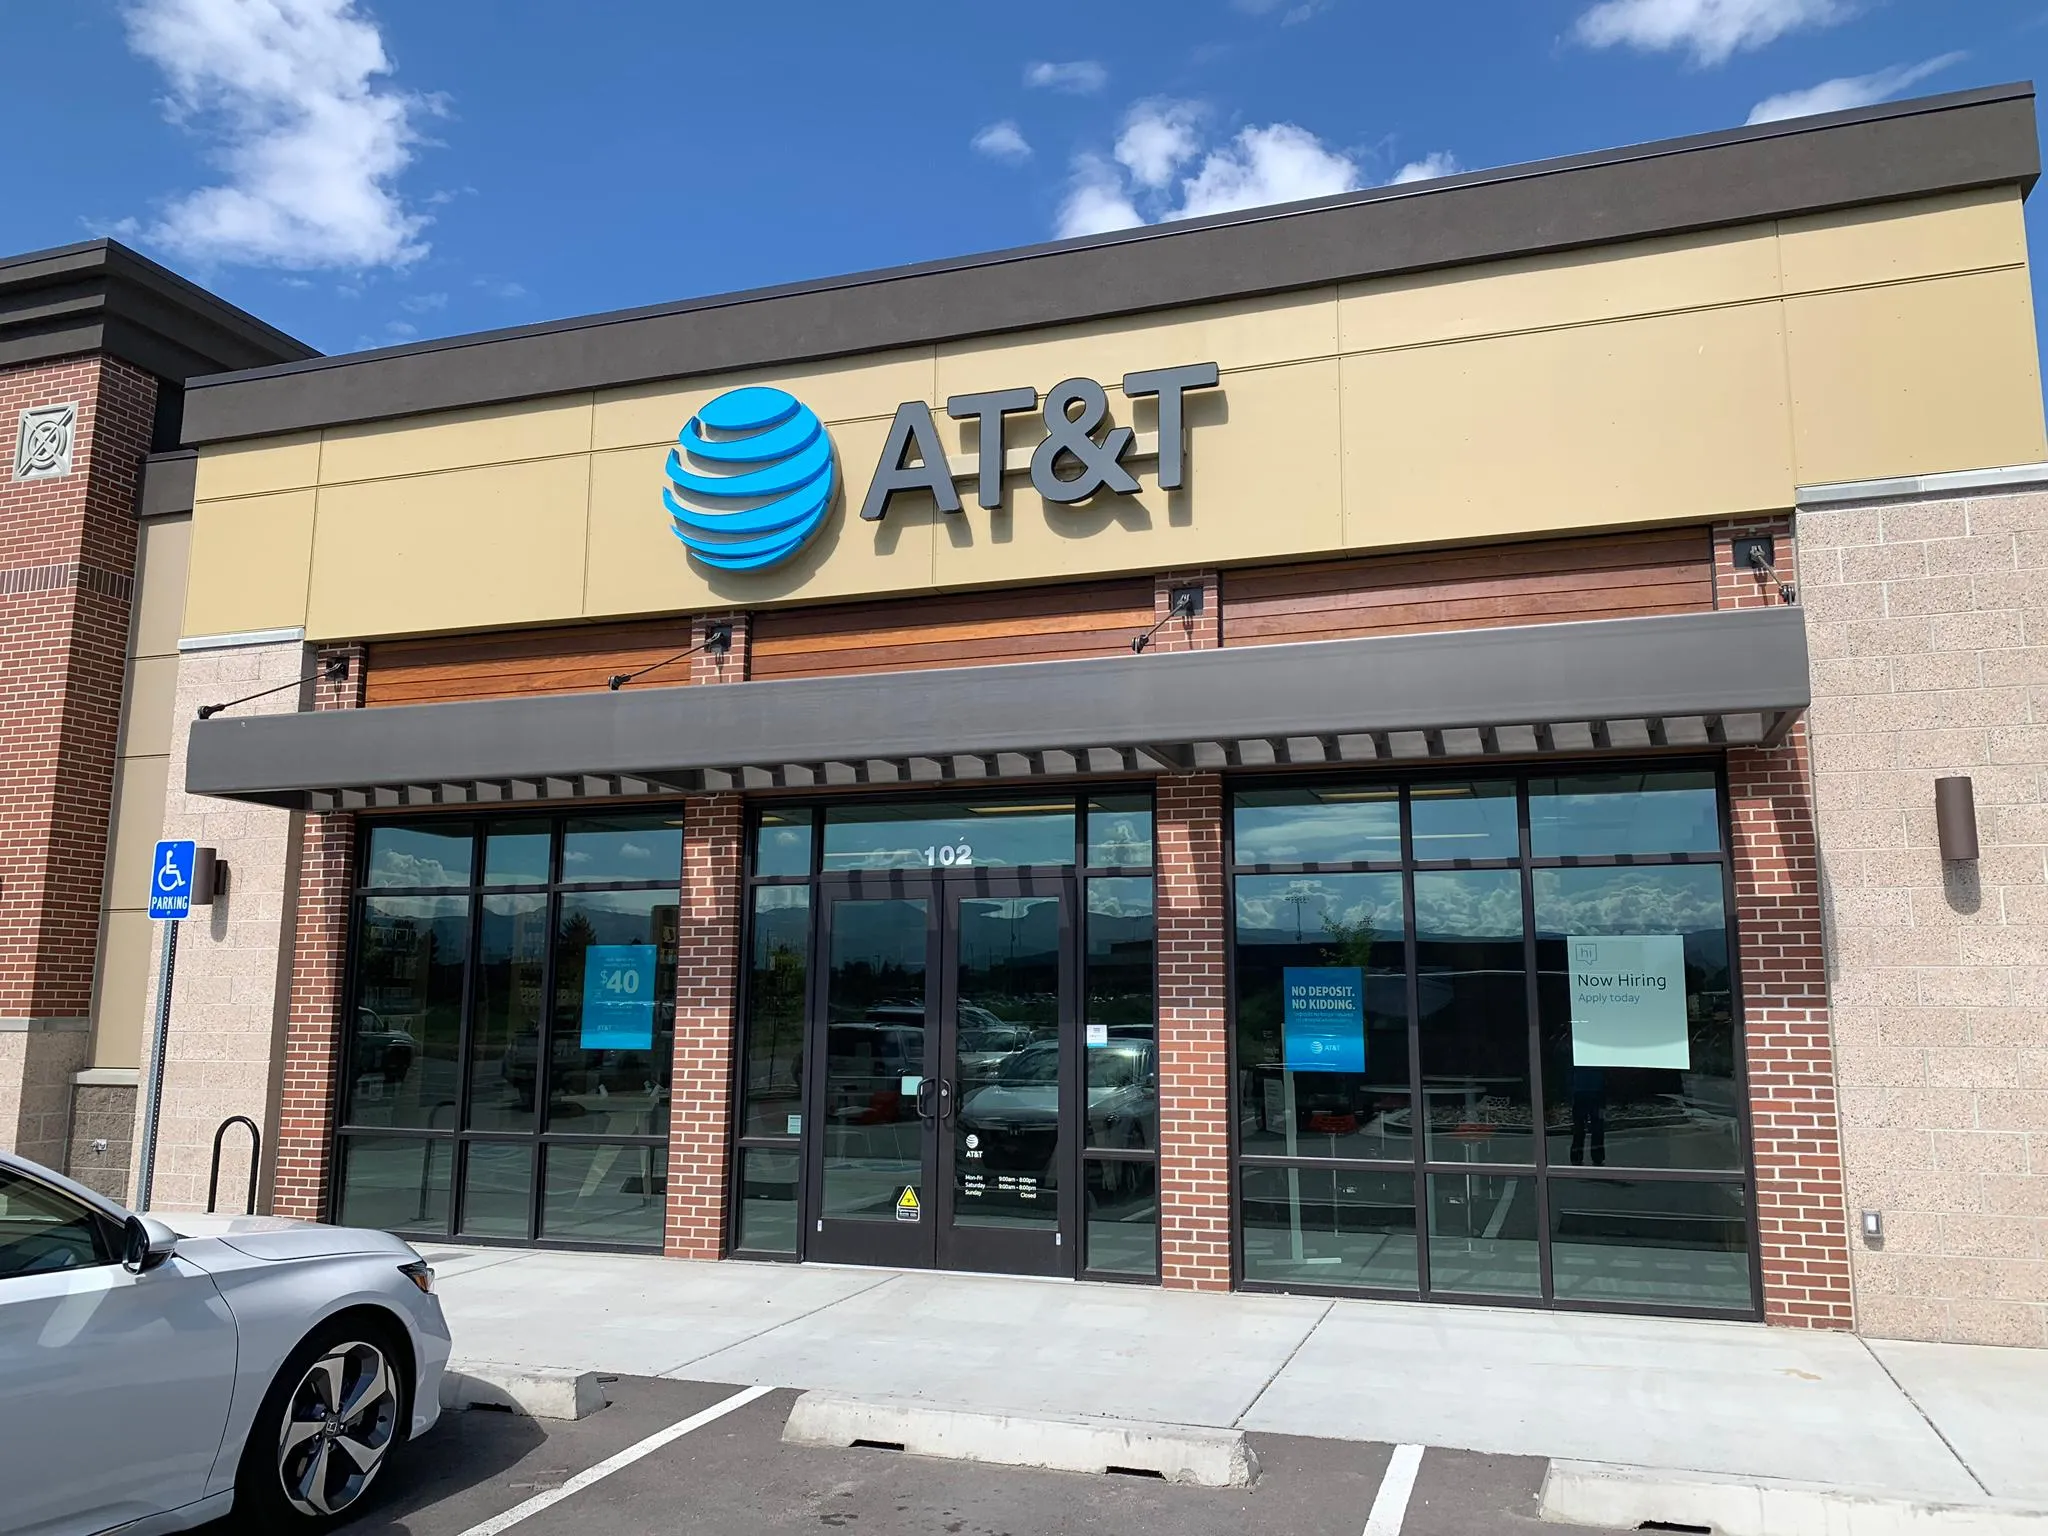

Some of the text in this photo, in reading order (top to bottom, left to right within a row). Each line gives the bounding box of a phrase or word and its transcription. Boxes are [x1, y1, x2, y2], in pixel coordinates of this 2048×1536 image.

[860, 362, 1220, 521] AT&T
[924, 844, 972, 867] 102
[151, 895, 189, 910] PARKING
[1580, 947, 1593, 958] hi
[600, 969, 640, 994] $40
[1578, 973, 1667, 991] Now Hiring
[1291, 986, 1356, 997] NO DEPOSIT.
[1292, 999, 1356, 1010] NO KIDDING.
[1578, 993, 1641, 1005] Apply today
[1323, 1044, 1341, 1052] AT&T
[965, 1150, 984, 1158] AT&T
